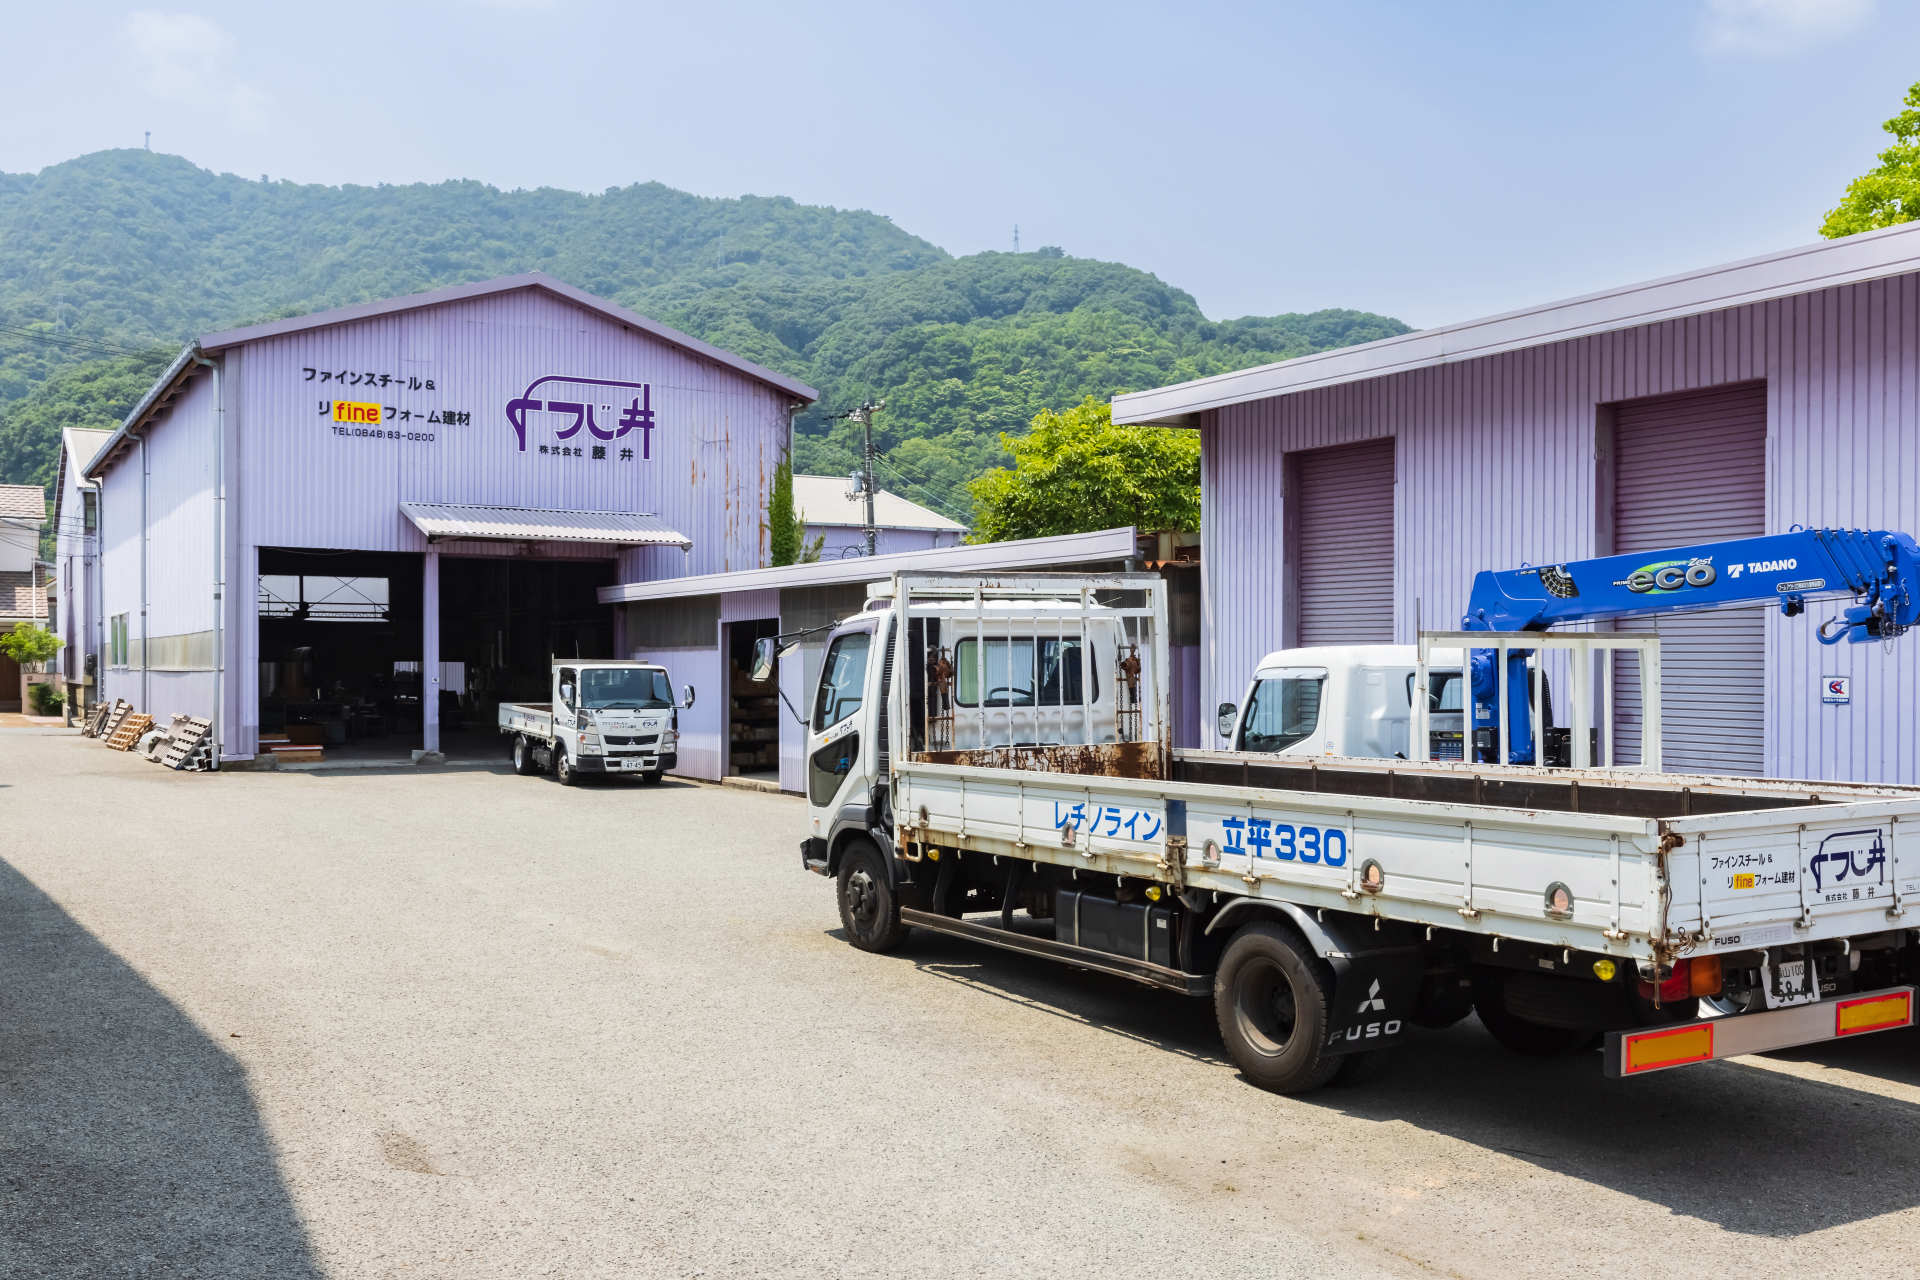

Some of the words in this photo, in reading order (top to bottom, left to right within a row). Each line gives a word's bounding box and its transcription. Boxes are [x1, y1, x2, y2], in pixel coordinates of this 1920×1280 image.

[539, 445, 583, 457] 株式会社
[1748, 558, 1797, 574] TADANO
[1626, 564, 1717, 593] eco
[1222, 816, 1347, 867] 立平330
[1714, 935, 1741, 946] FUSO
[1328, 1020, 1402, 1046] FUSO
